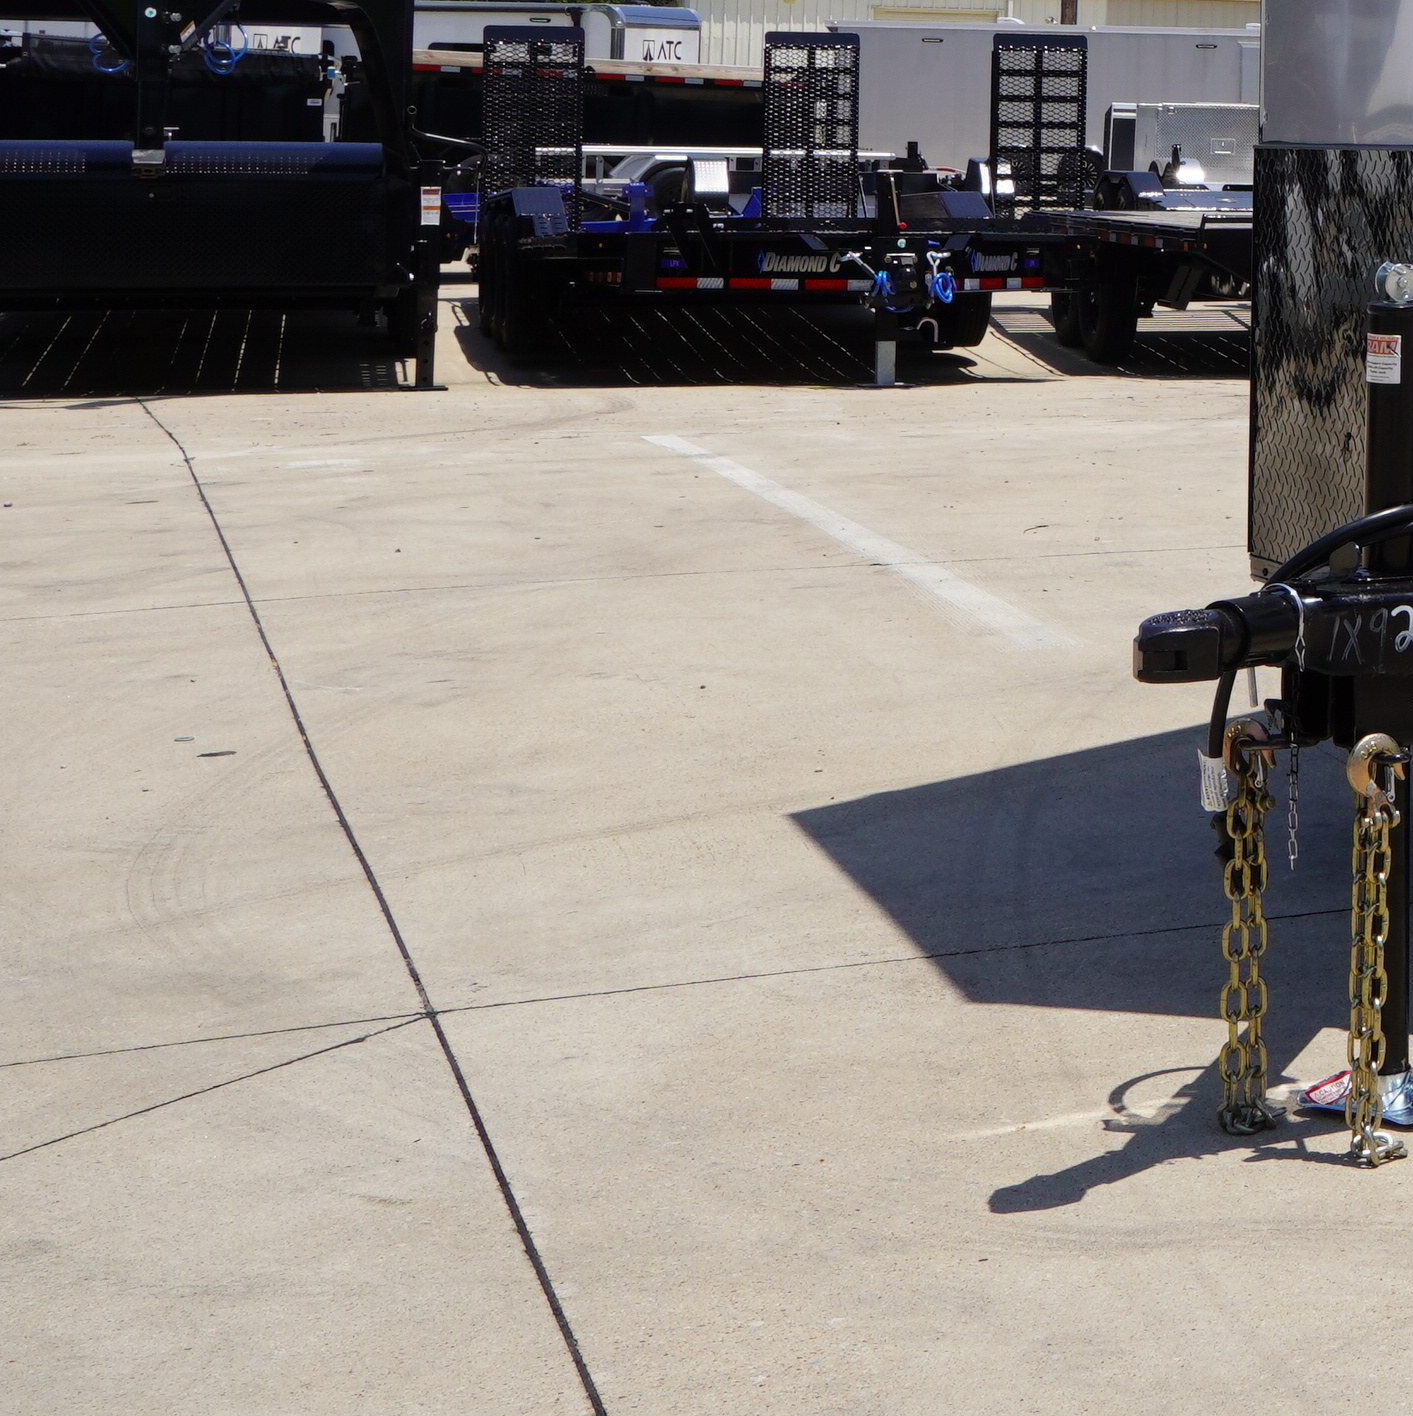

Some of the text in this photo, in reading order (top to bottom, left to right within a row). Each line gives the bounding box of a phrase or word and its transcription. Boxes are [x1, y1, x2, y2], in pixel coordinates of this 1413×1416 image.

[657, 40, 682, 61] ATC
[763, 252, 842, 273] DIAMOND C
